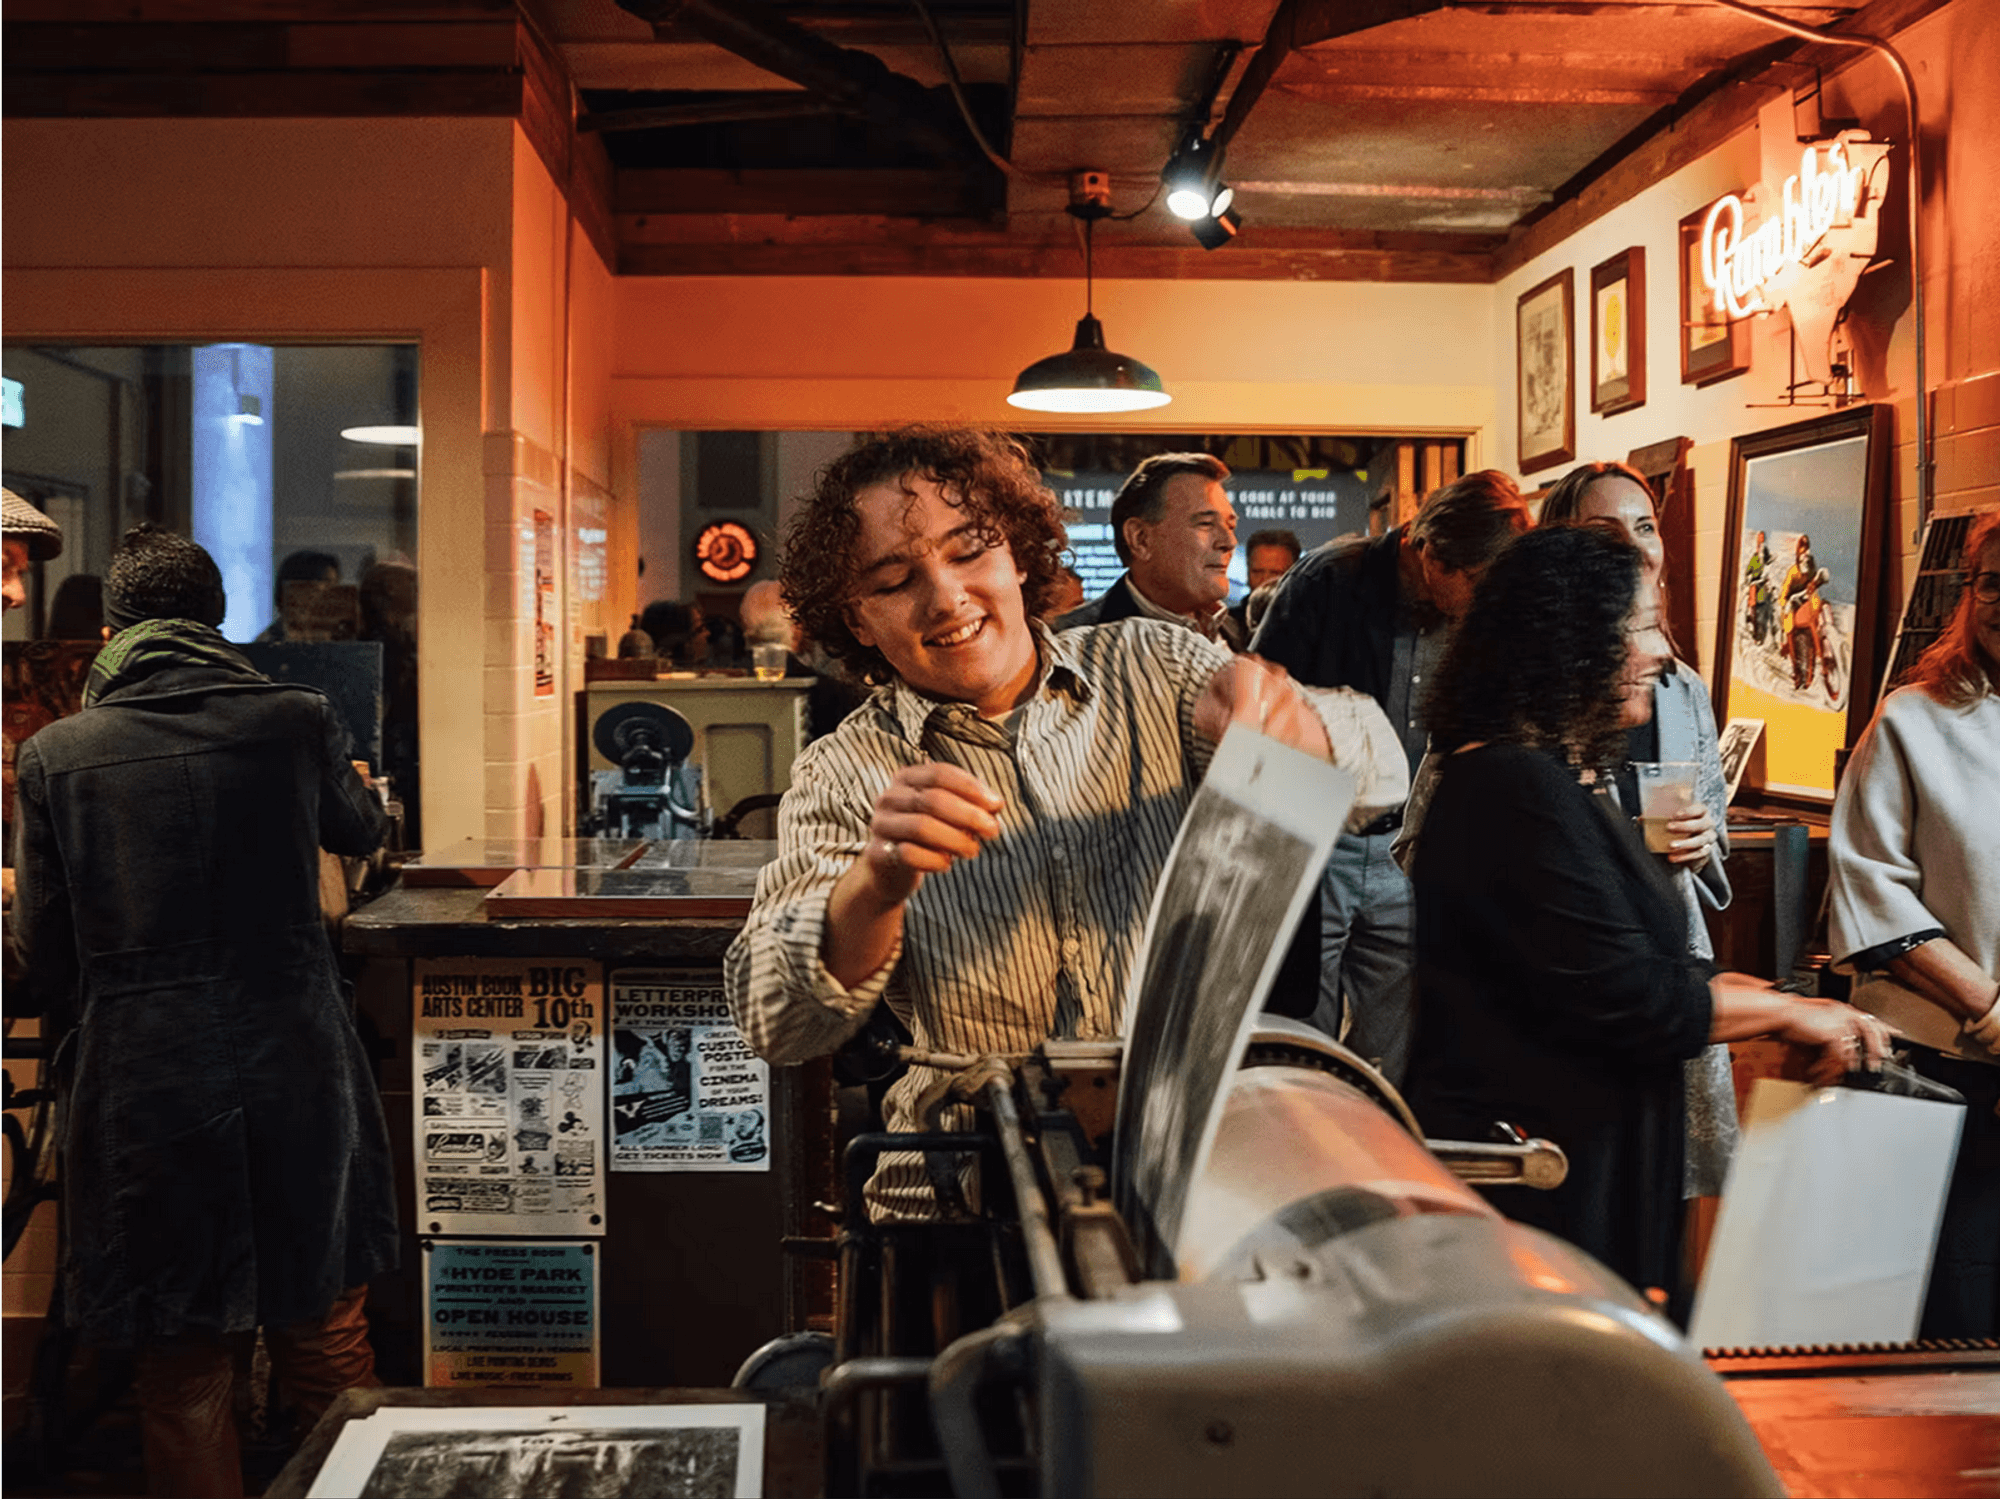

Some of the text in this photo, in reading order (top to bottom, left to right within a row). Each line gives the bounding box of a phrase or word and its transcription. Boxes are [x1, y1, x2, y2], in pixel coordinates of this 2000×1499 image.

[1279, 490, 1296, 504] AT
[1300, 490, 1337, 504] YOUR
[1245, 505, 1336, 519] TABLE TO BID
[421, 974, 523, 996] AUSTIN BOOK
[528, 966, 588, 997] BIG
[615, 988, 727, 1002] LETTERPR
[421, 996, 524, 1018] ARTS CENTER
[533, 998, 594, 1029] 10th
[616, 1004, 730, 1018] WORKSHO
[697, 1040, 746, 1052] CUSTO
[703, 1050, 755, 1063] POSTE
[700, 1073, 759, 1086] CINEMA
[699, 1094, 763, 1108] DREAMS!
[615, 1152, 640, 1160] GET
[643, 1152, 694, 1160] TICKETS
[456, 1247, 482, 1256] THE
[451, 1267, 582, 1281] HYDE PARK
[519, 1285, 588, 1295] MARKET
[497, 1297, 526, 1305] AND
[435, 1309, 588, 1325] OPEN HOUSE
